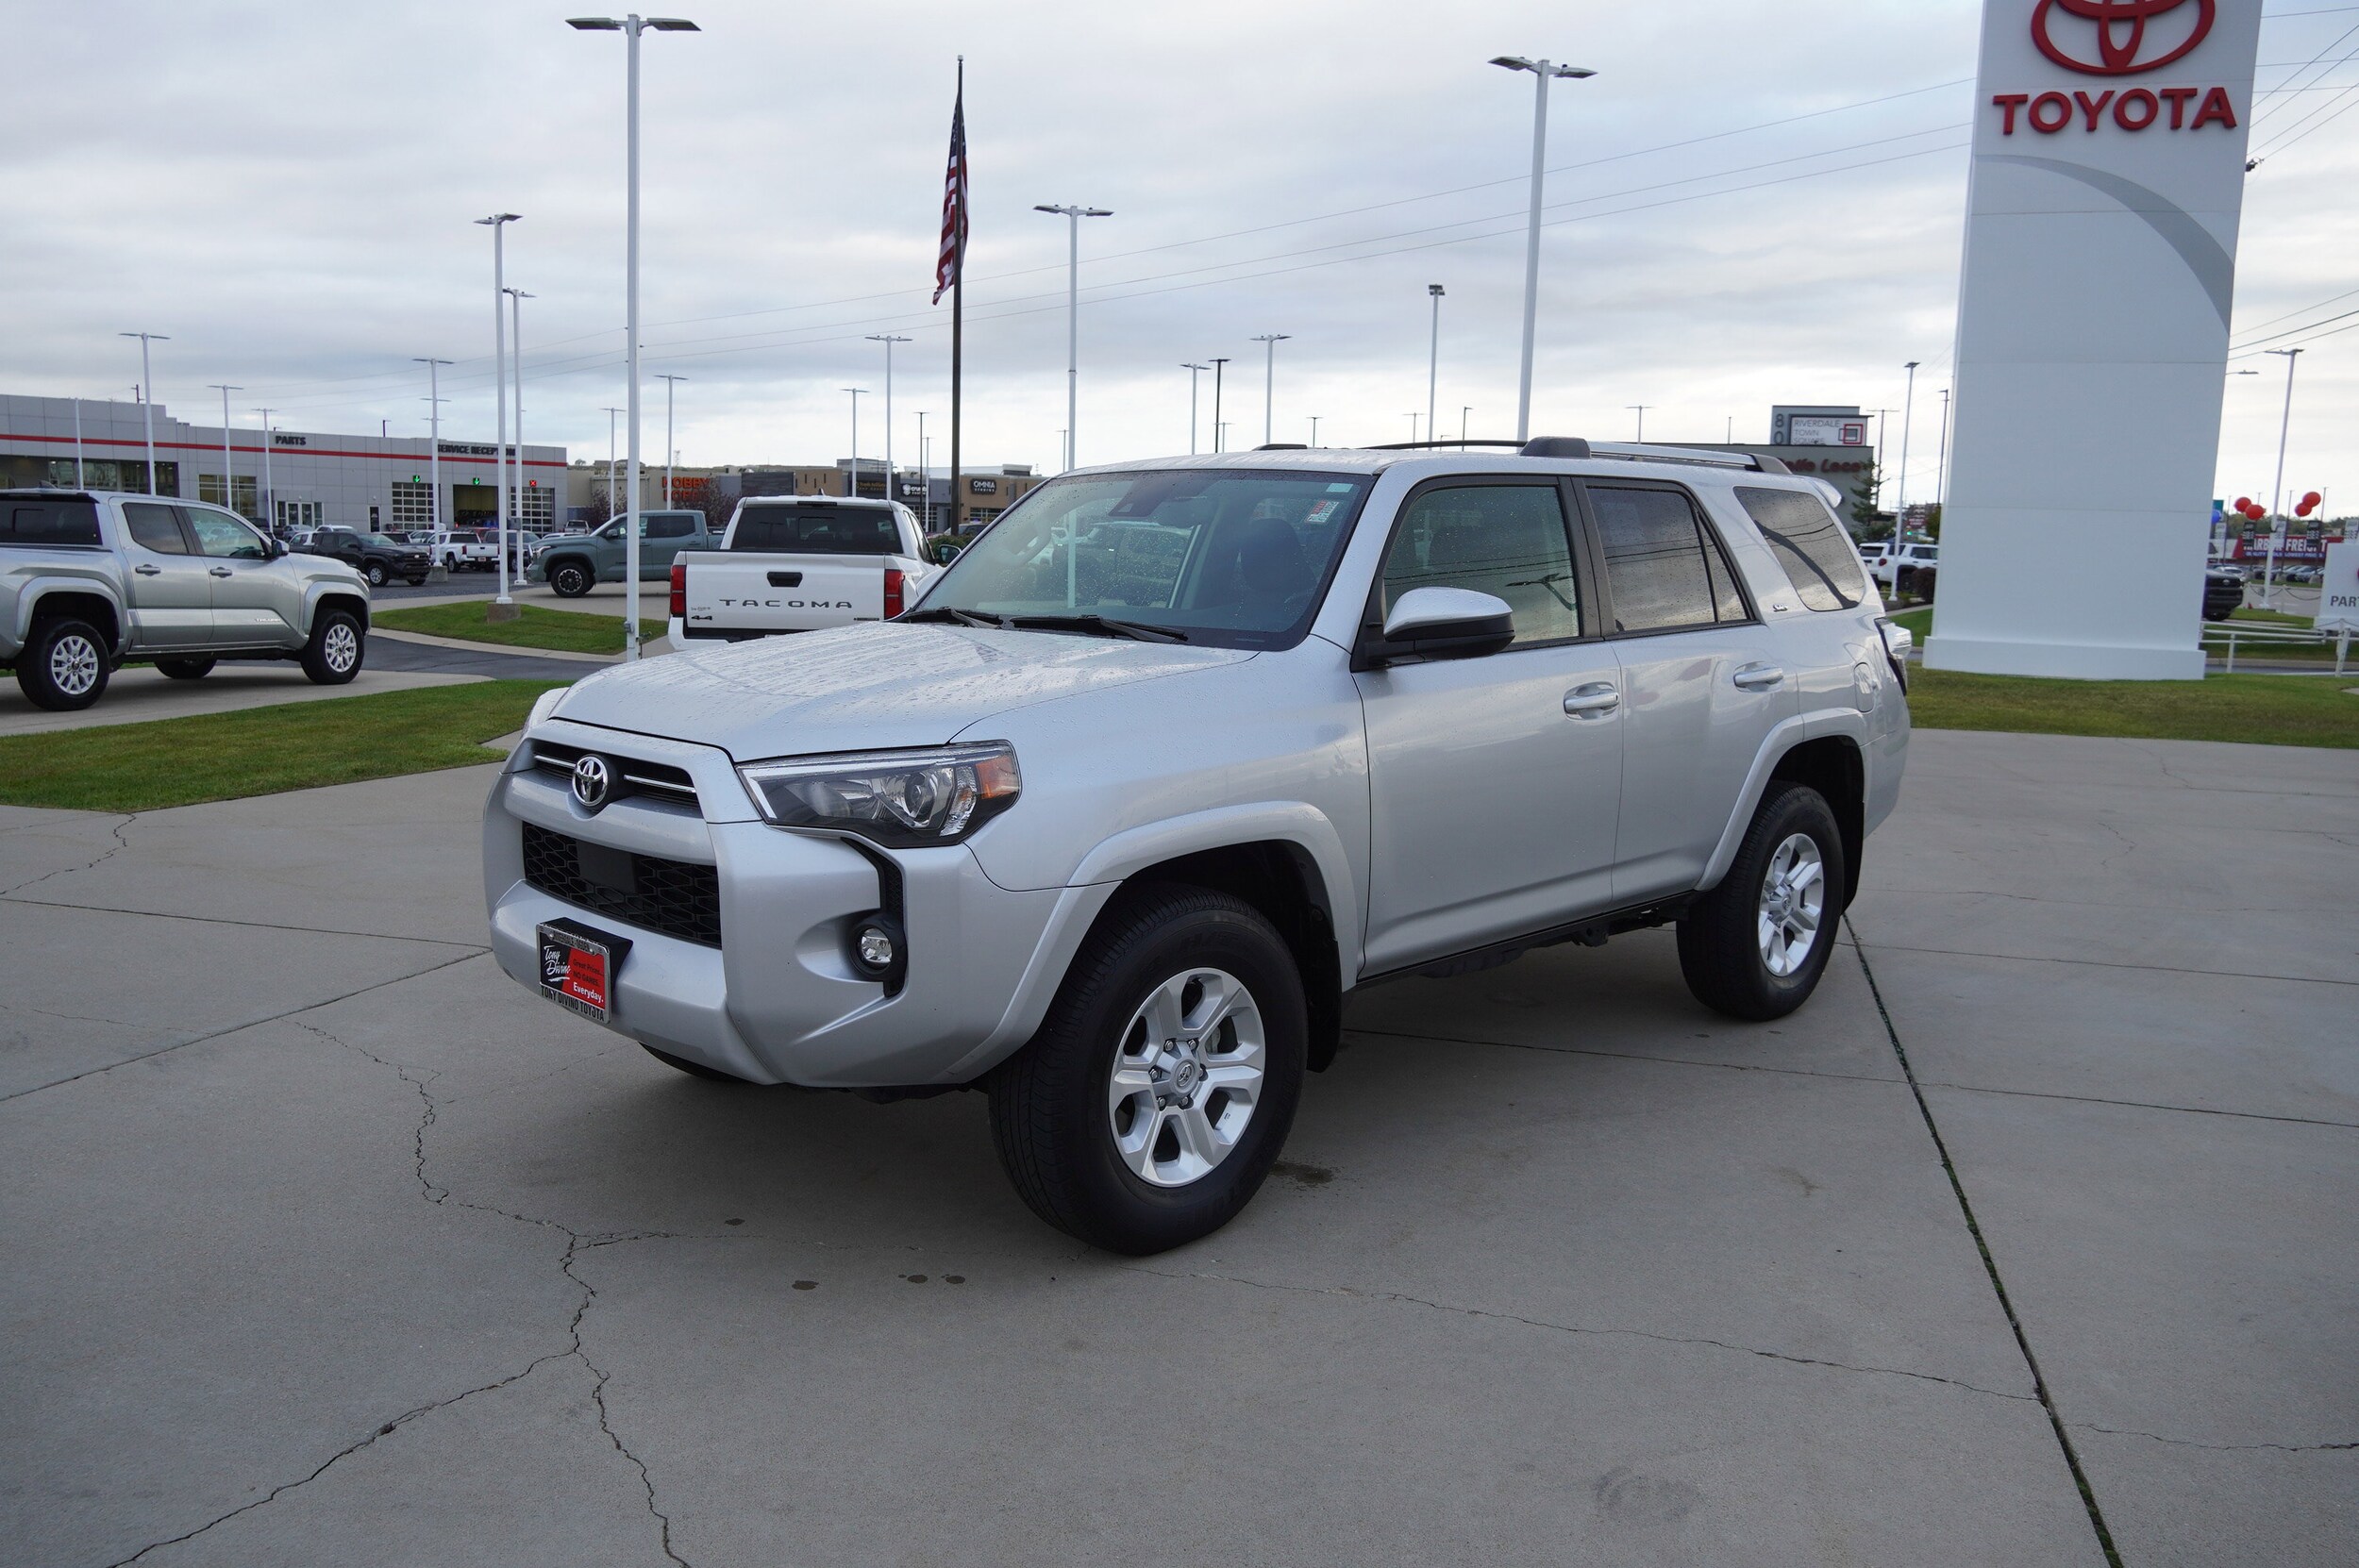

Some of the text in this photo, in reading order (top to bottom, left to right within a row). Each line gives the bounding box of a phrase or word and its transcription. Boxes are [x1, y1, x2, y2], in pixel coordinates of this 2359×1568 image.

[1992, 87, 2237, 136] TOYOTA
[1794, 419, 1841, 427] RIVERDALE
[275, 435, 307, 445] PARTS
[471, 446, 515, 456] RECEPTON
[973, 480, 995, 489] OMNIA
[2285, 539, 2328, 552] FREIT
[719, 599, 853, 609] TACOMA
[2330, 595, 2359, 608] PAR
[544, 945, 560, 962] Tony
[541, 985, 557, 1001] TONY
[558, 992, 578, 1010] DIVINO
[573, 981, 604, 1003] Everyday.
